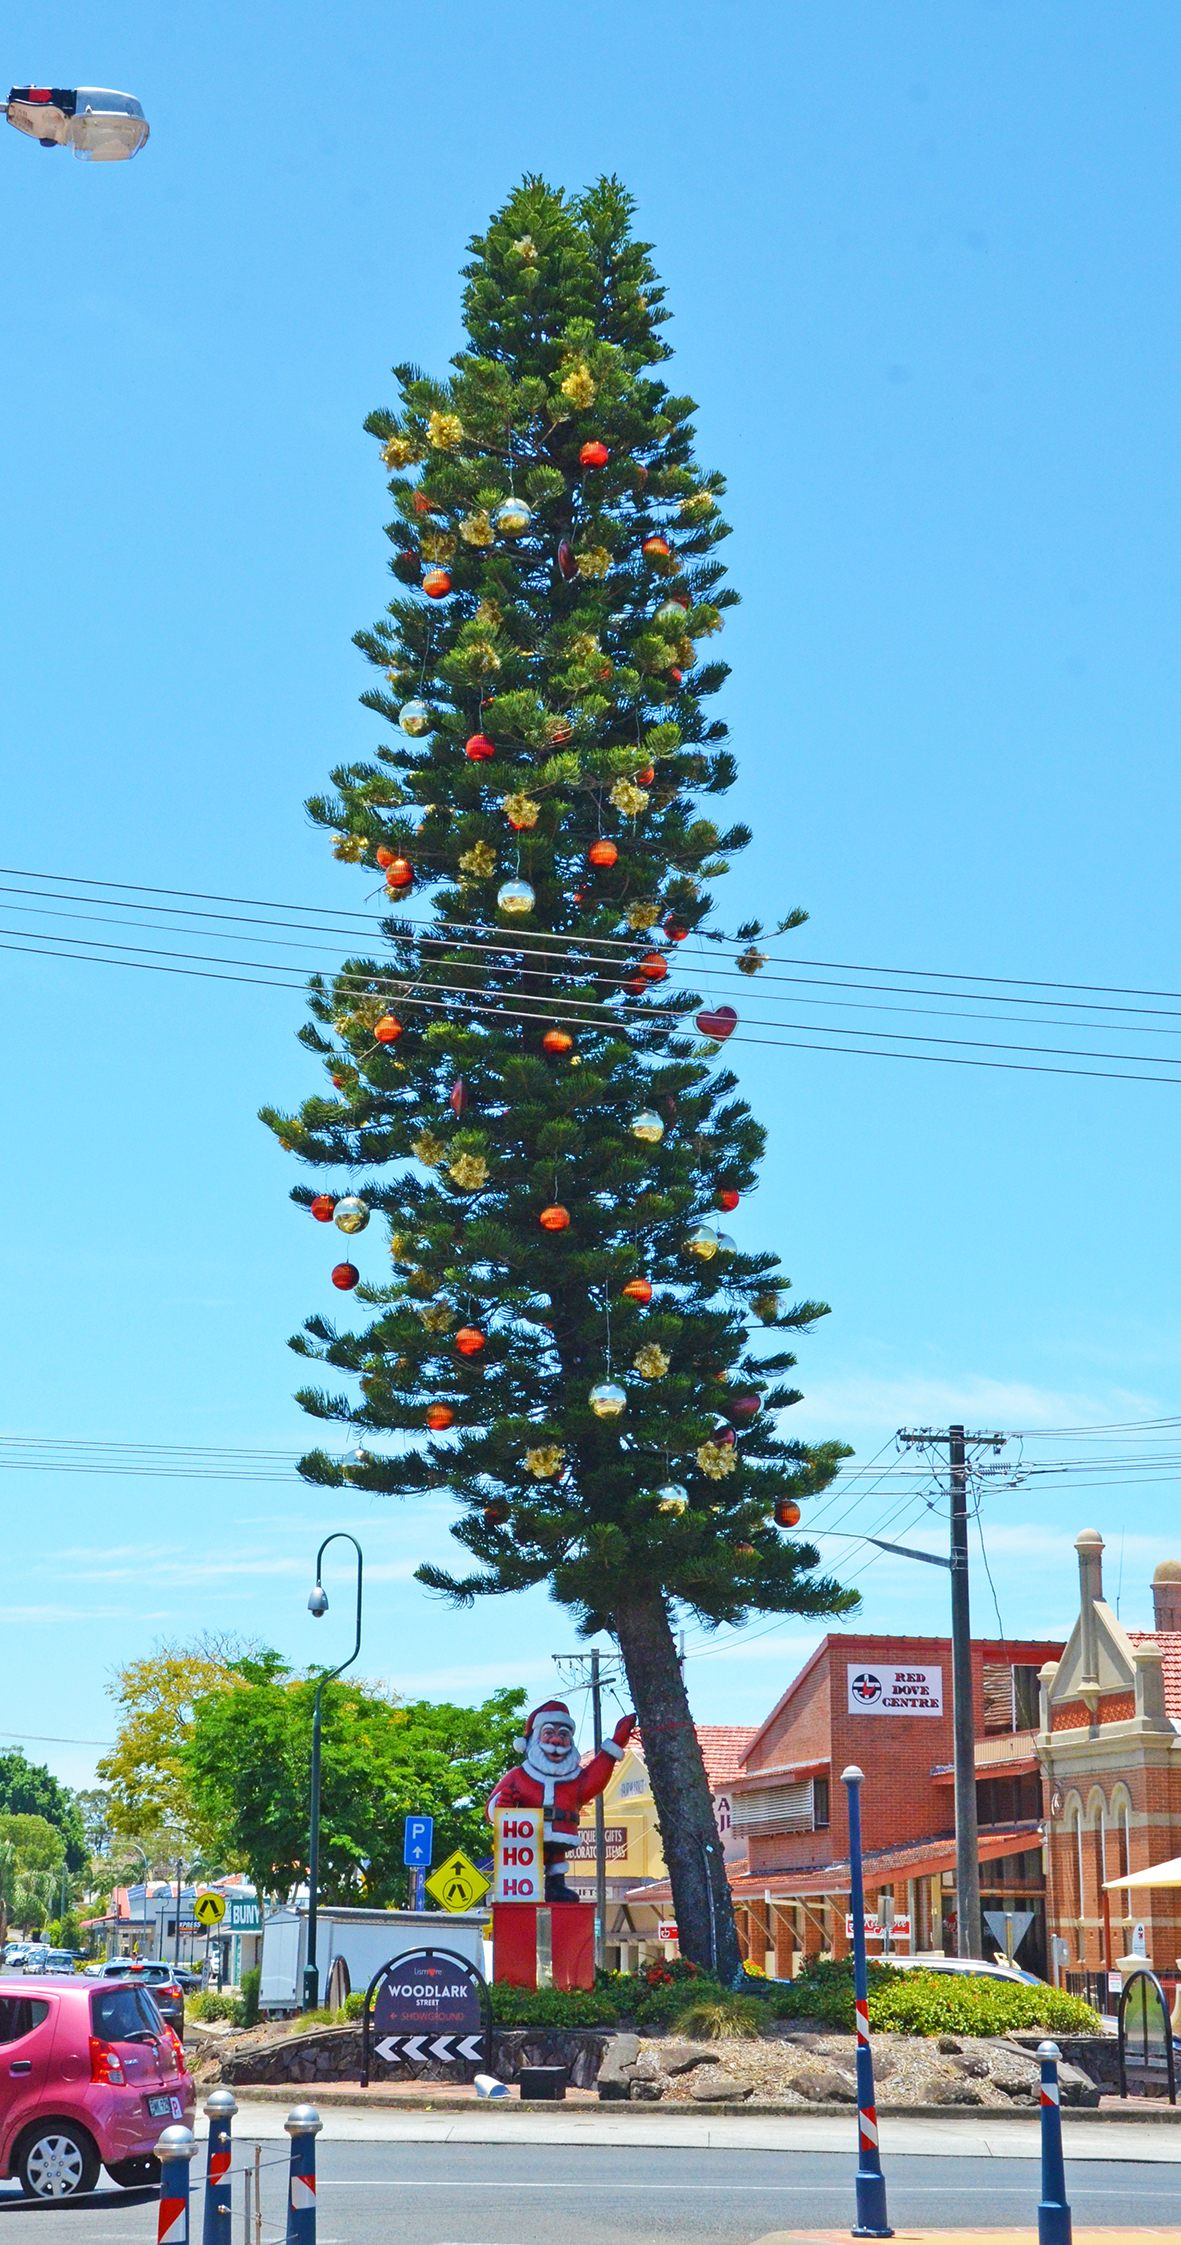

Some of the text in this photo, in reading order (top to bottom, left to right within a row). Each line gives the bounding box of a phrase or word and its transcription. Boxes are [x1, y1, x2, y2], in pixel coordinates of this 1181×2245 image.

[895, 1672, 926, 1683] RED
[892, 1685, 930, 1696] DOVE
[882, 1697, 940, 1709] CENTRE
[412, 1823, 425, 1840] P
[503, 1820, 534, 1839] HO
[604, 1829, 623, 1843] GIFTS
[503, 1847, 534, 1867] HO
[503, 1878, 534, 1897] HO
[388, 1985, 468, 1998] WOODLARK
[416, 1999, 440, 2007] STREET
[401, 2011, 465, 2022] SHOWGROUND
